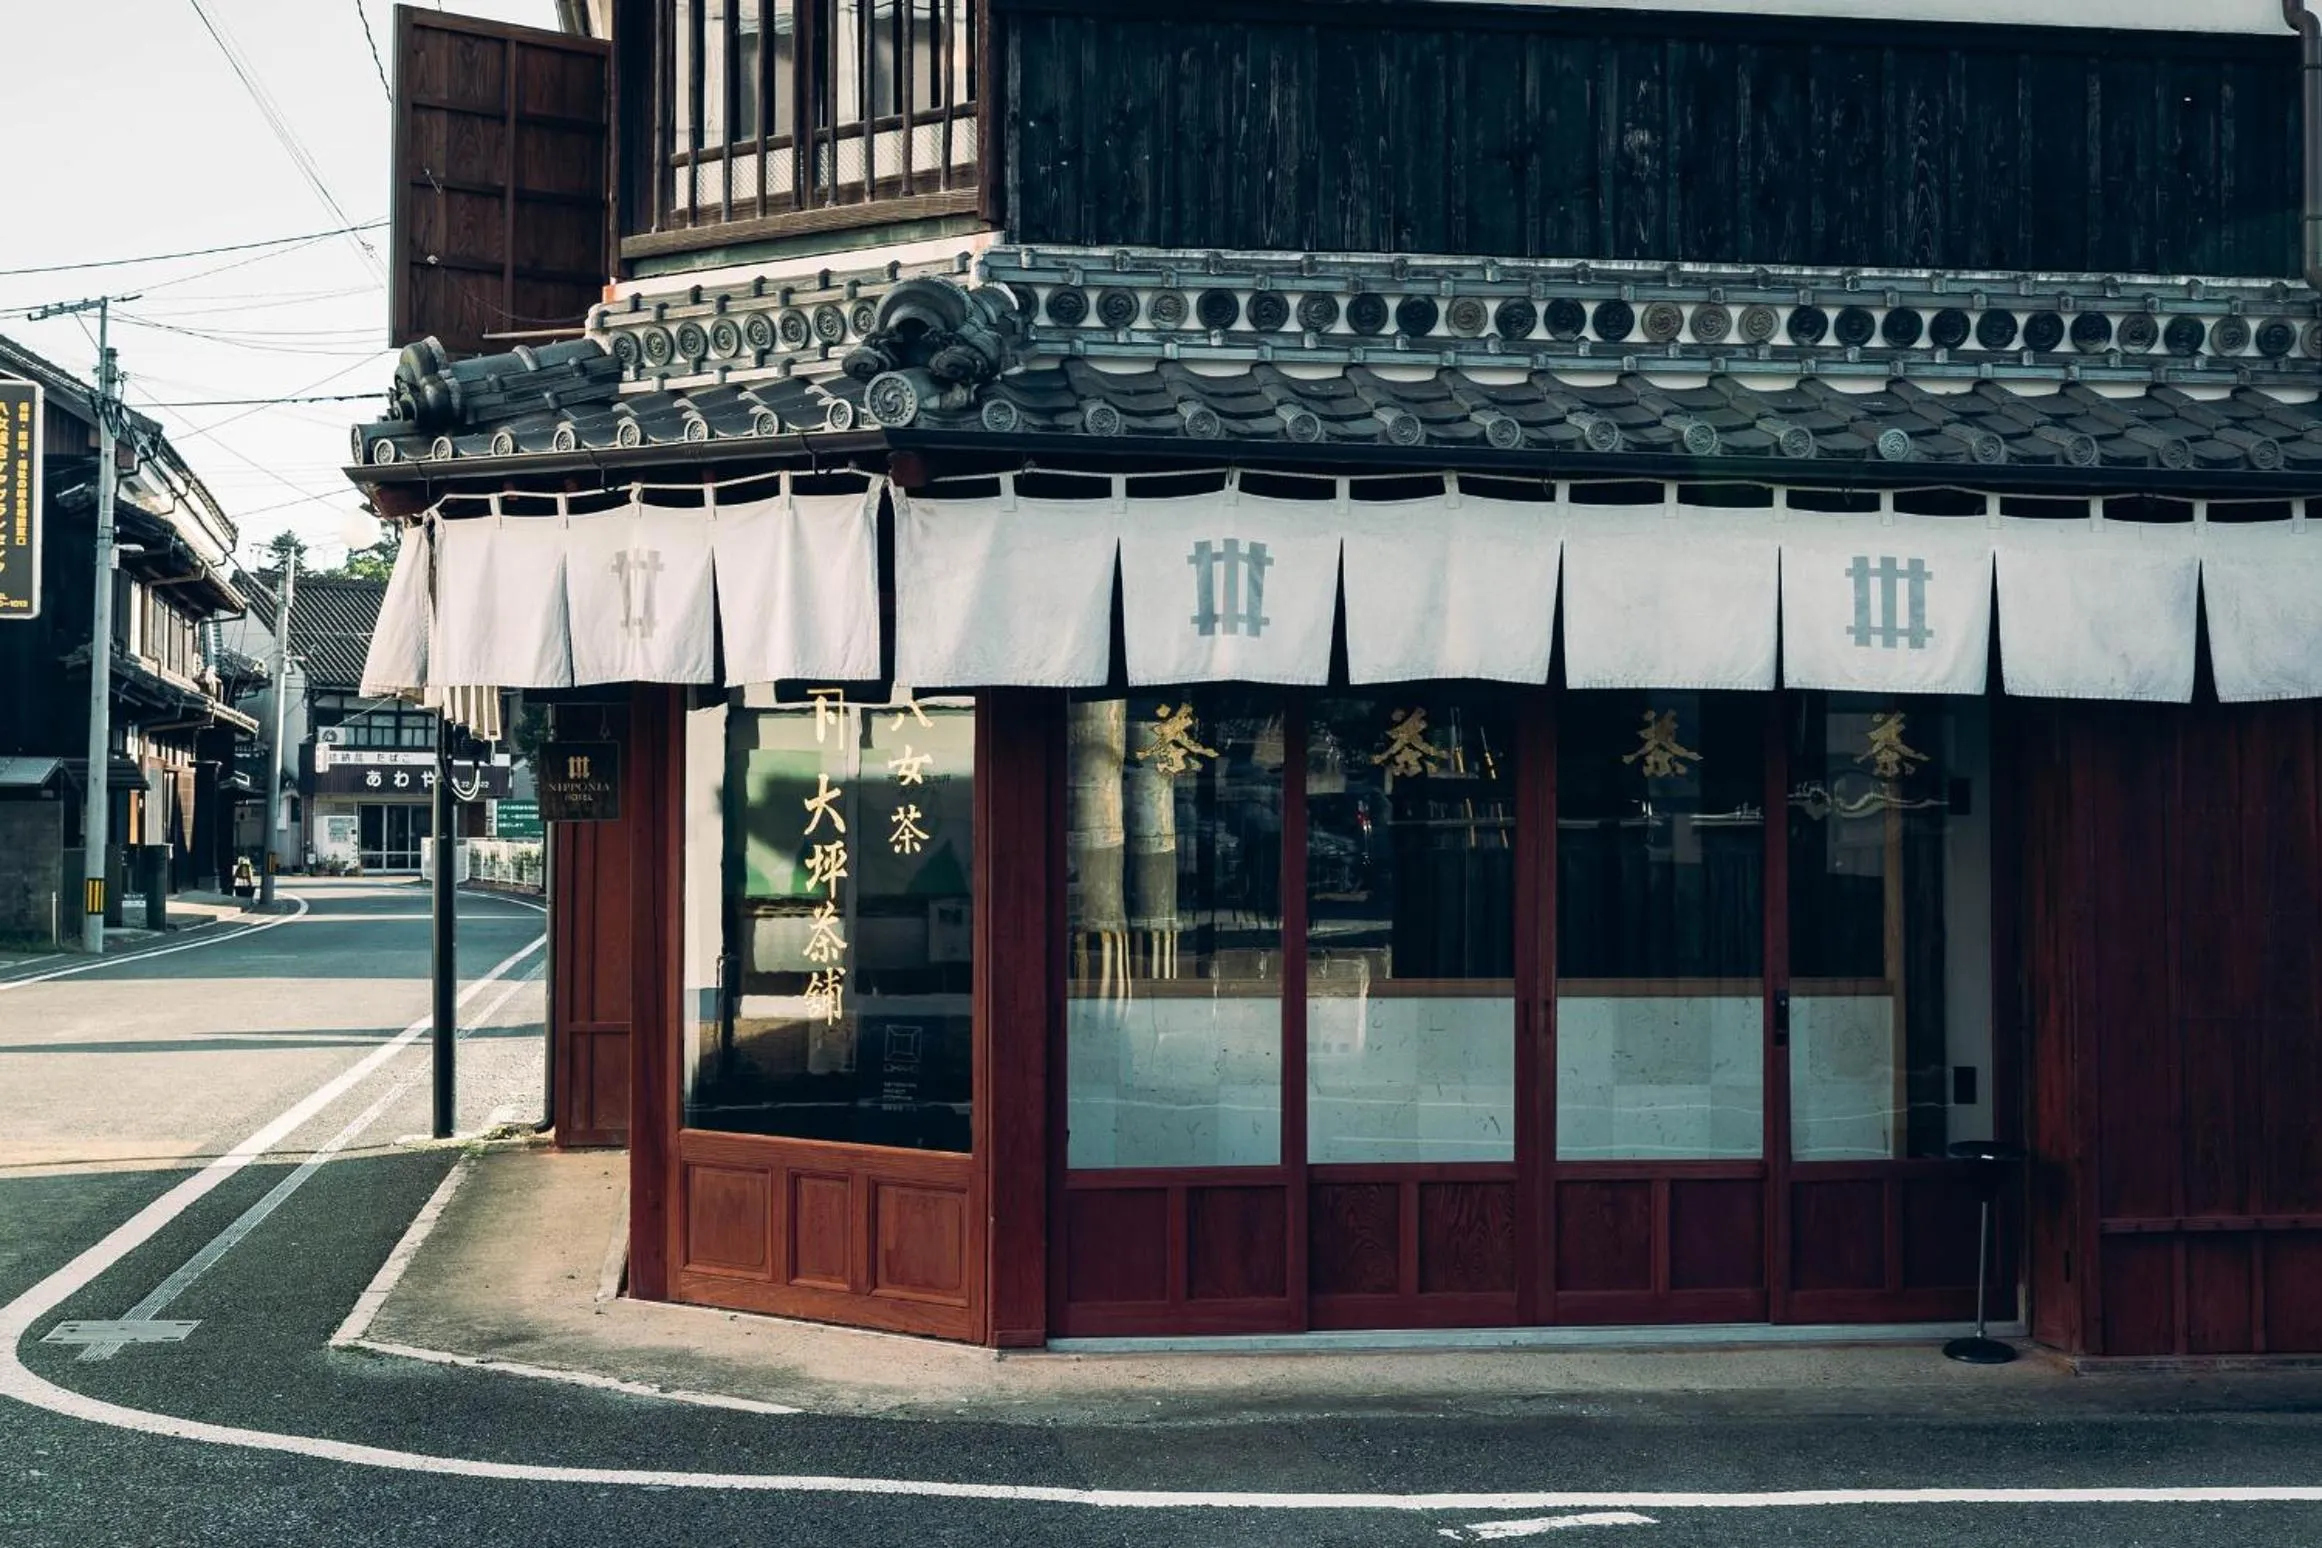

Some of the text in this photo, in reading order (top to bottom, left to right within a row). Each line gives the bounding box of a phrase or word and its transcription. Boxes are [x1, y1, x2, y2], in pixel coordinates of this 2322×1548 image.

[366, 770, 436, 787] あわや
[889, 699, 933, 854] 八女茶
